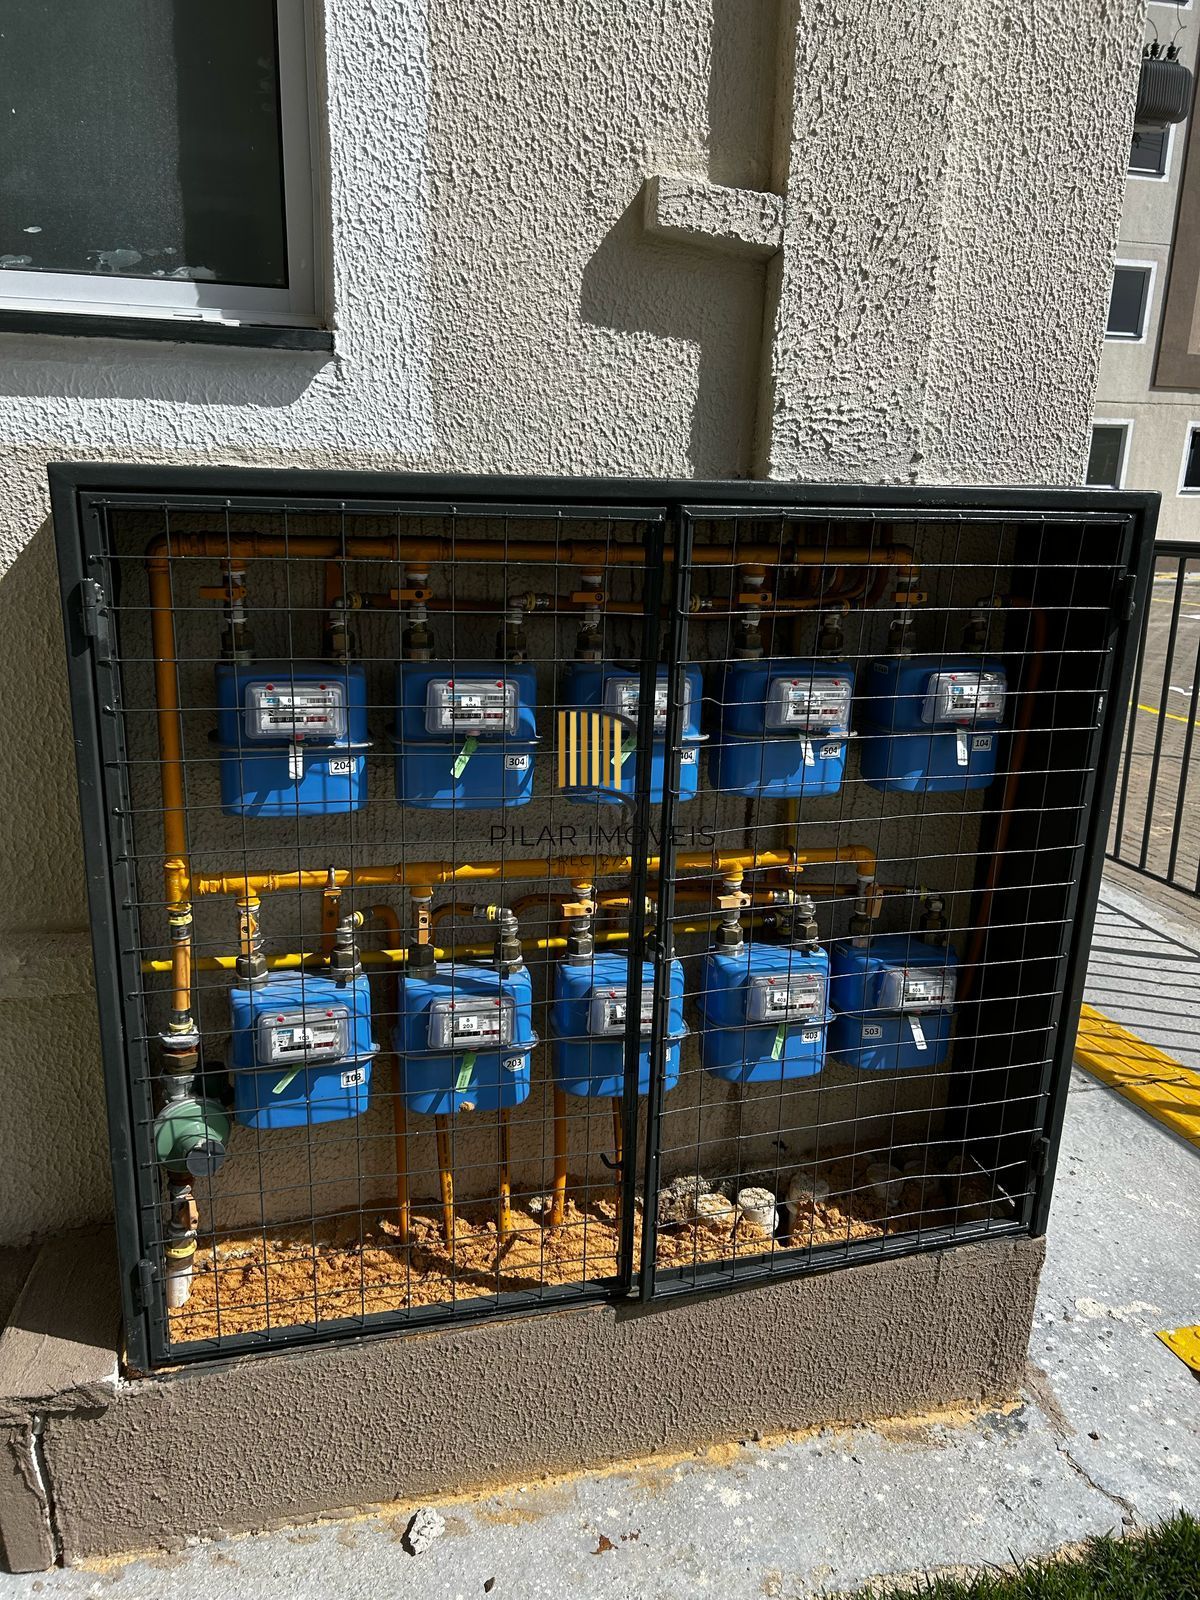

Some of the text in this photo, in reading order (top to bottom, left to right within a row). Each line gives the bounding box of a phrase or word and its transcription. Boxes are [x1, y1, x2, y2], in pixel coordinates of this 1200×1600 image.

[975, 739, 989, 747] 104
[823, 746, 838, 755] 504
[333, 761, 351, 771] 204
[508, 757, 525, 766] 304
[804, 1031, 818, 1040] 403
[864, 1028, 879, 1036] 503
[506, 1059, 522, 1068] 203
[345, 1073, 362, 1084] 103
